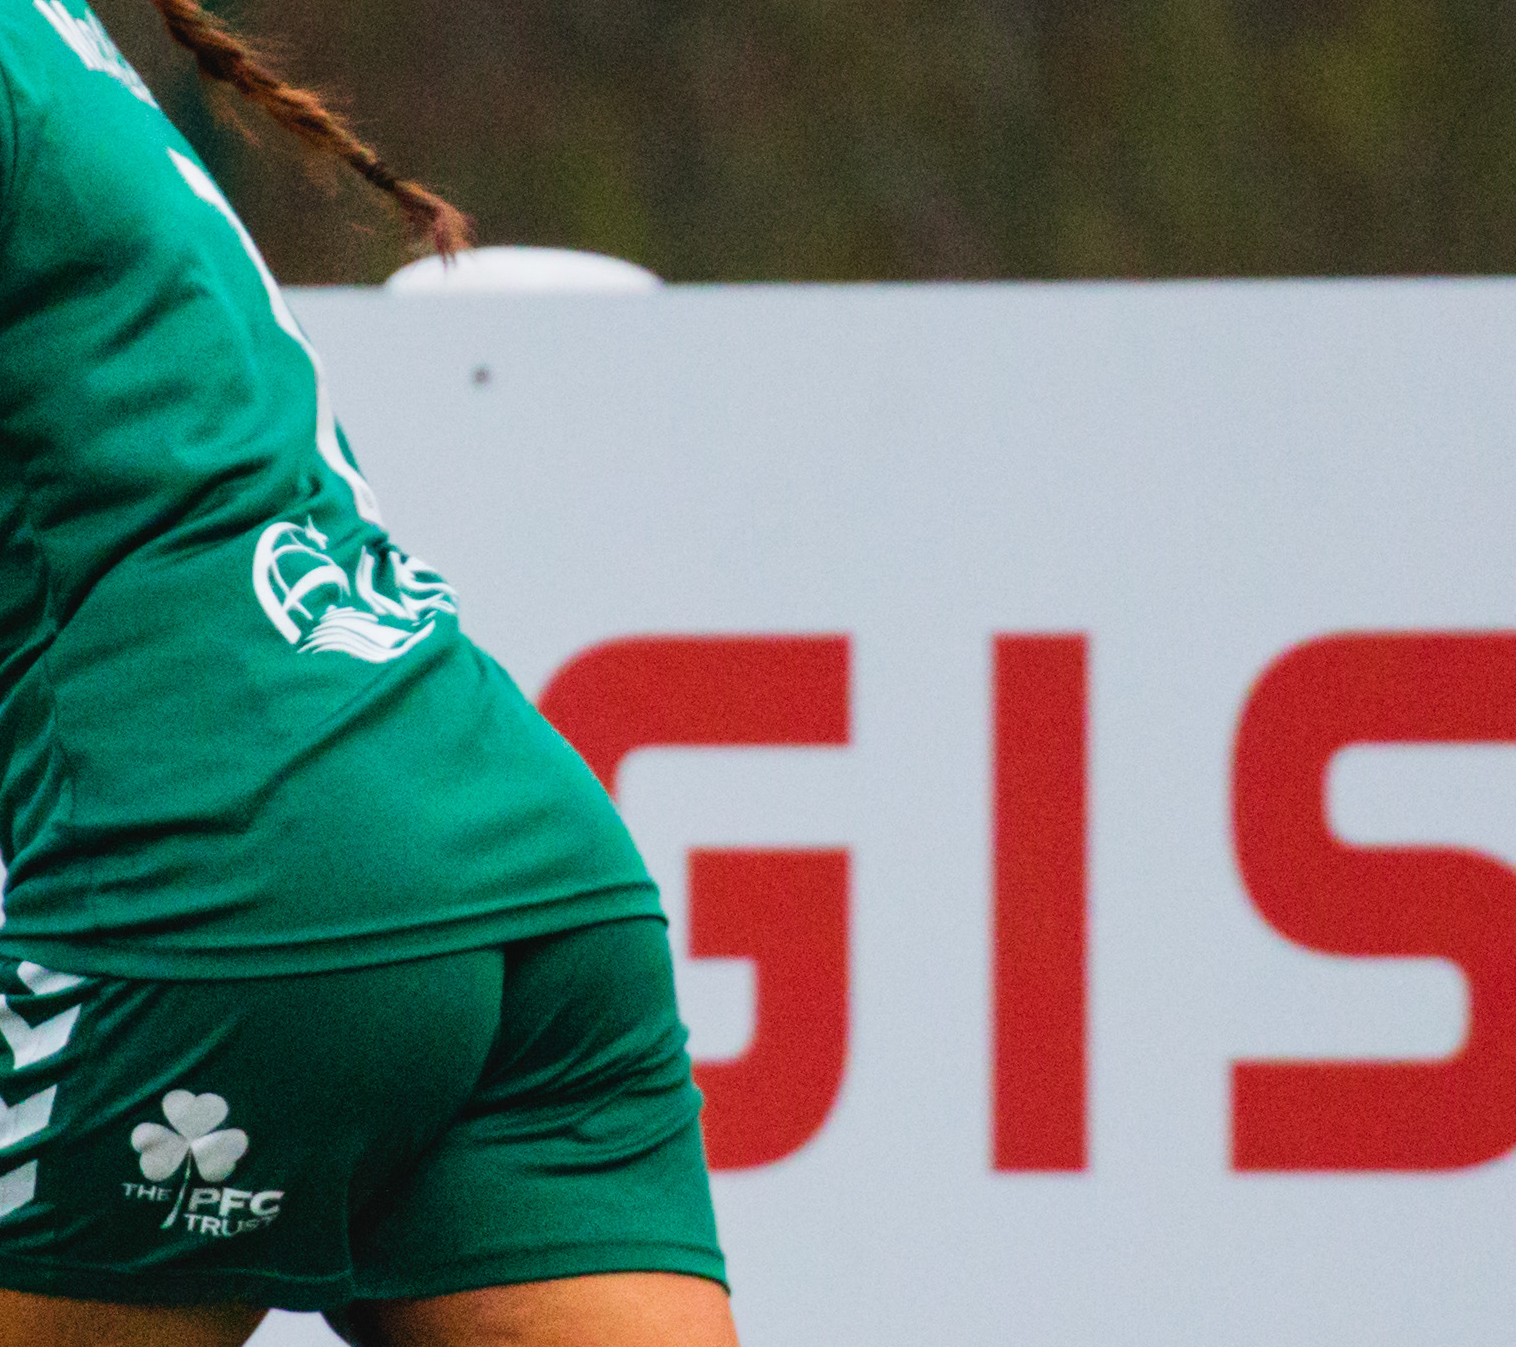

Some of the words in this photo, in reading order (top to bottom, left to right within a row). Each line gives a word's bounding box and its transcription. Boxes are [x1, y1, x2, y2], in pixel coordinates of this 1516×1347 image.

[121, 1182, 173, 1203] THE
[187, 1186, 285, 1217] PFC
[183, 1212, 279, 1238] TRUST
